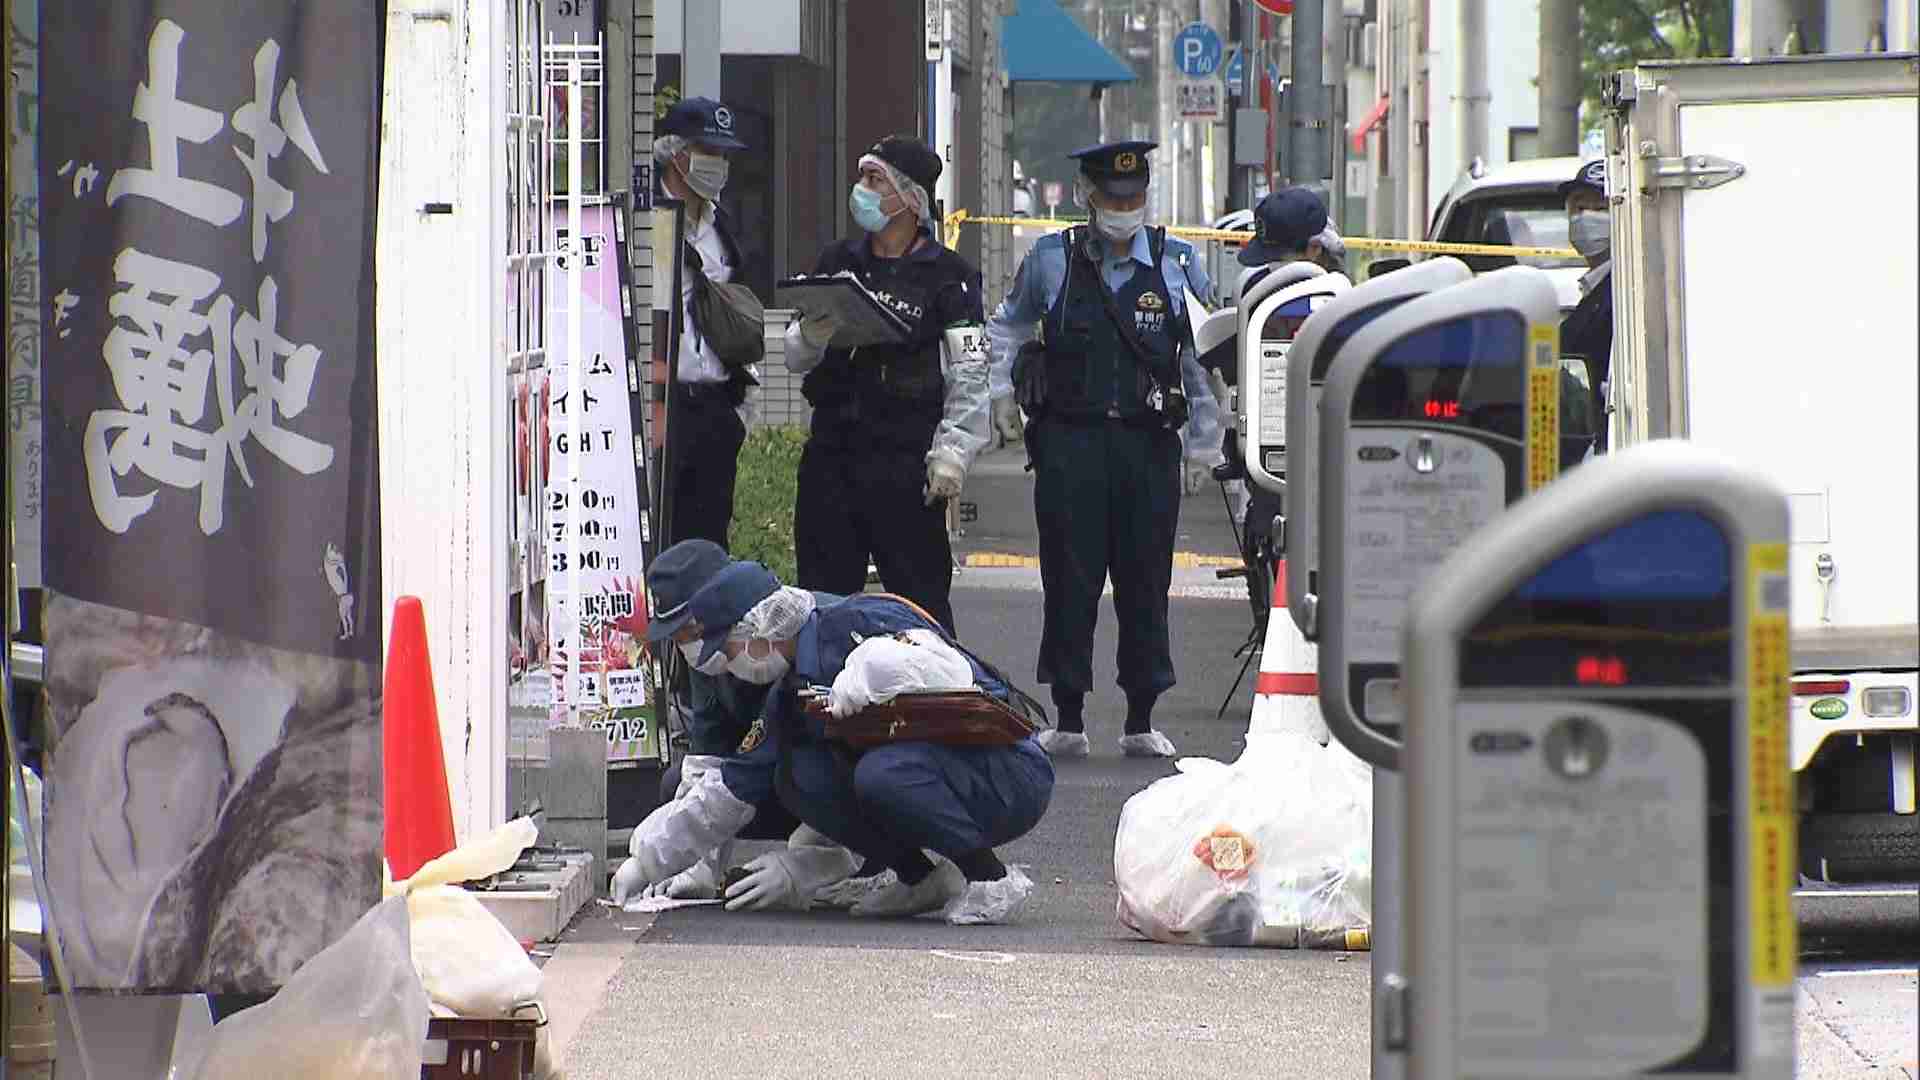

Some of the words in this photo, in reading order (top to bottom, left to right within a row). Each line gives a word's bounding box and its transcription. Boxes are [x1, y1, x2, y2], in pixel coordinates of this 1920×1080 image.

[549, 489, 615, 511] 20円
[552, 519, 617, 542] 70円
[579, 593, 632, 617] 時間
